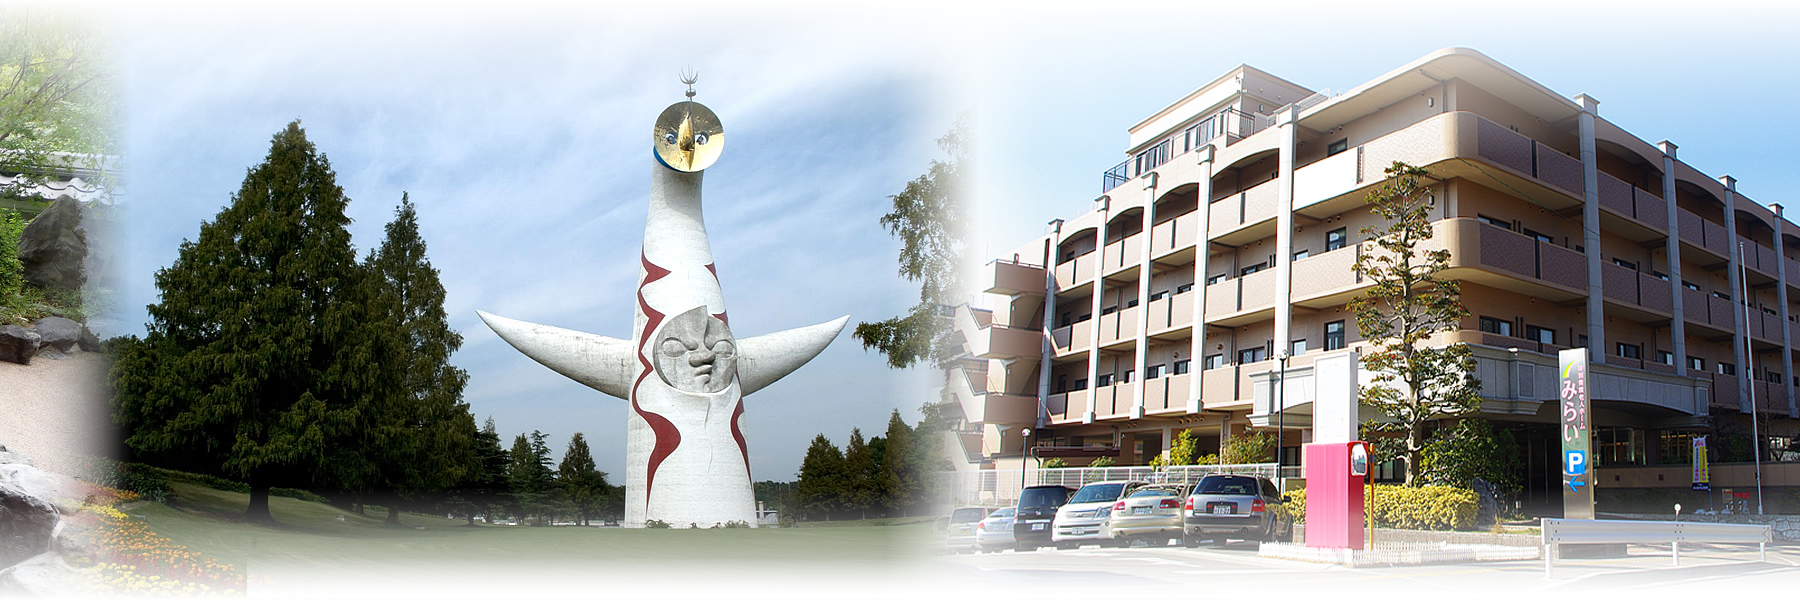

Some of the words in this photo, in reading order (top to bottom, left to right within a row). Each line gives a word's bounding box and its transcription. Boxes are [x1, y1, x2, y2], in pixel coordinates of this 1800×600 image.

[1561, 379, 1580, 443] みらい
[1568, 452, 1583, 473] P
